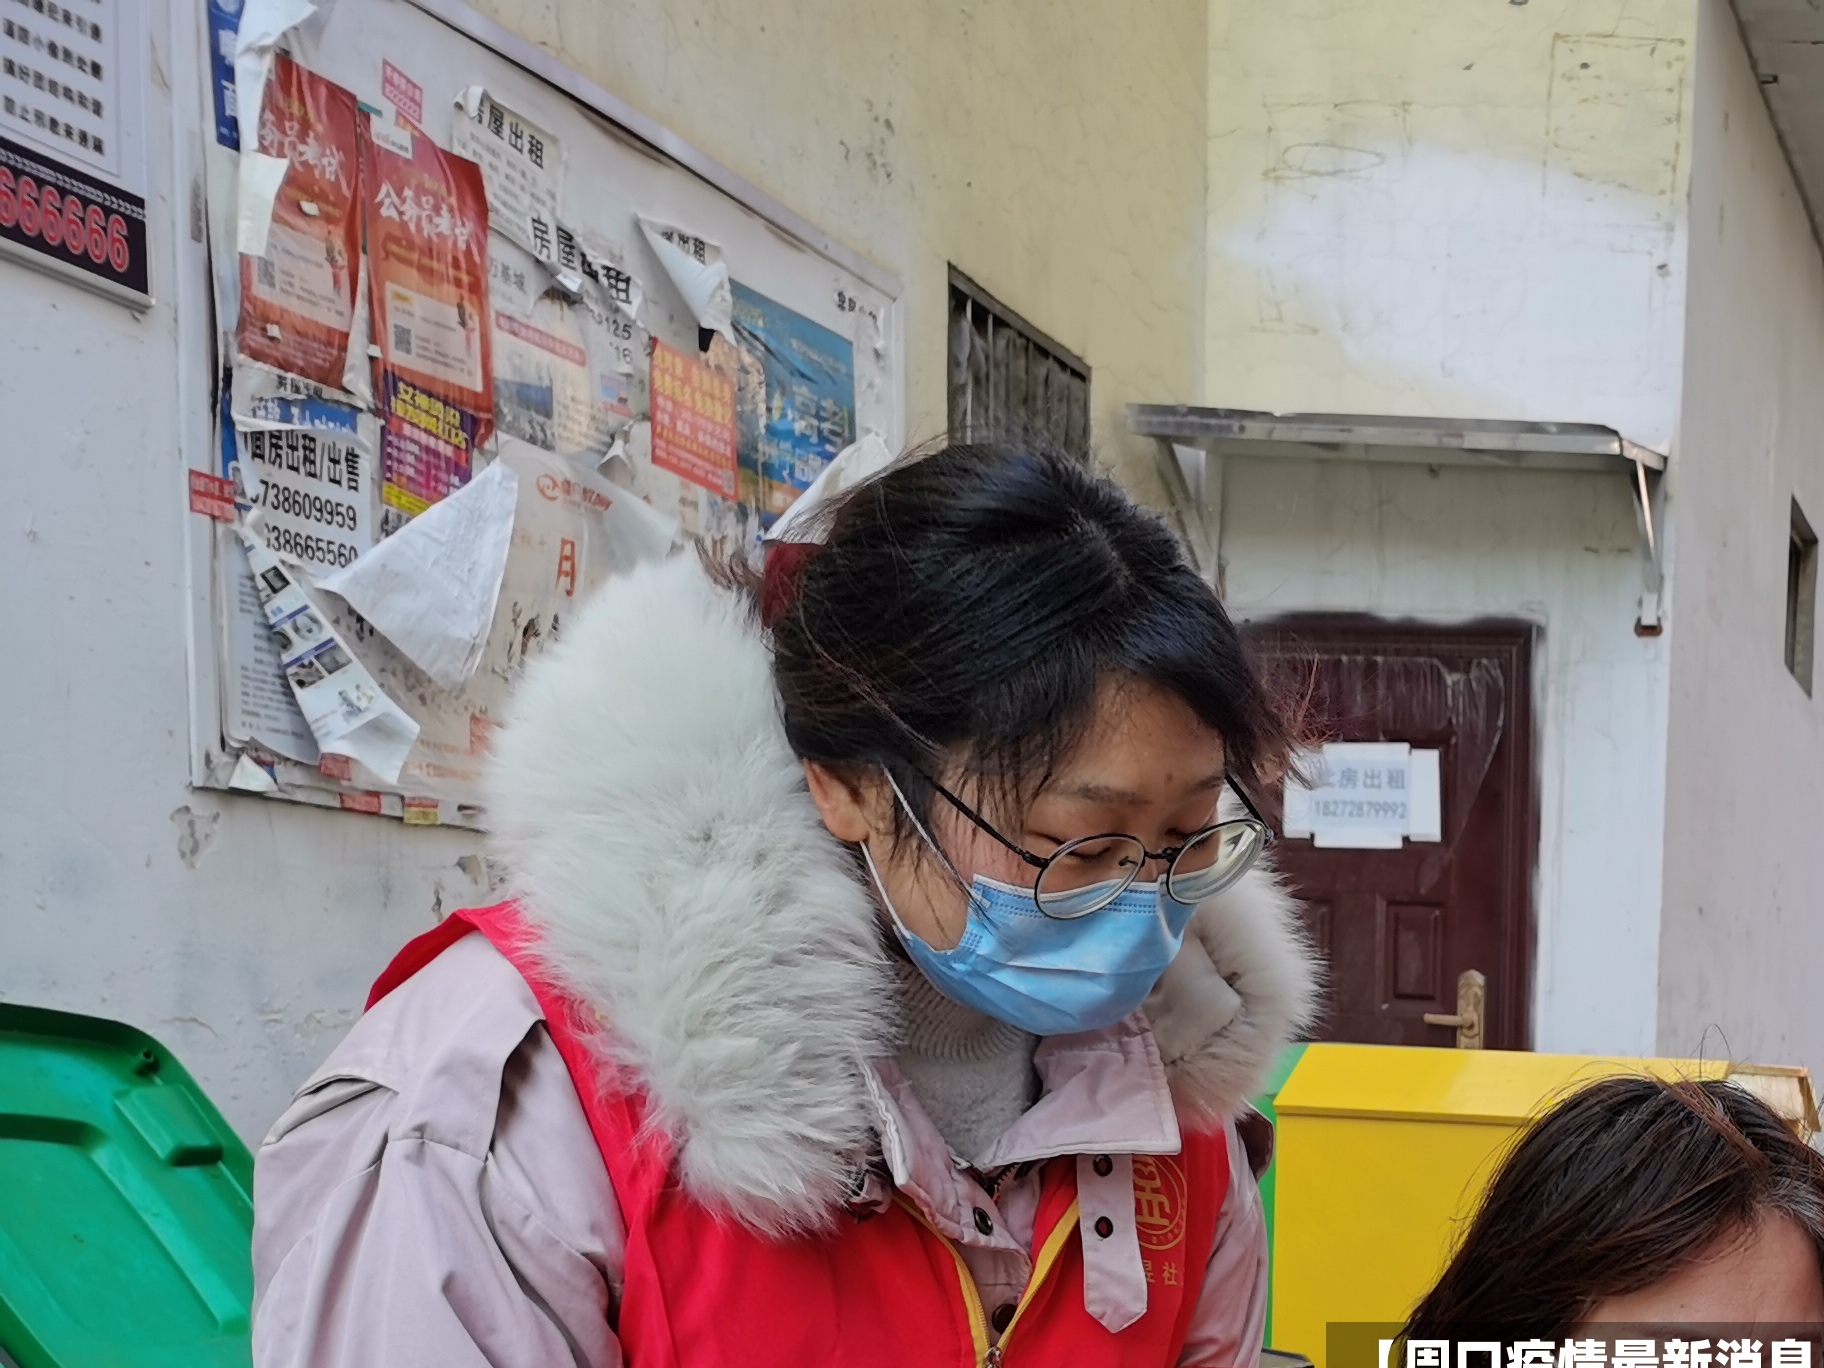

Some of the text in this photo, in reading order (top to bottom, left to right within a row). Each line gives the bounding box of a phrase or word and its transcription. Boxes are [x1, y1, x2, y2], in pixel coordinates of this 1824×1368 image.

[264, 523, 359, 569] 38665560
[1330, 767, 1406, 791] 房出租
